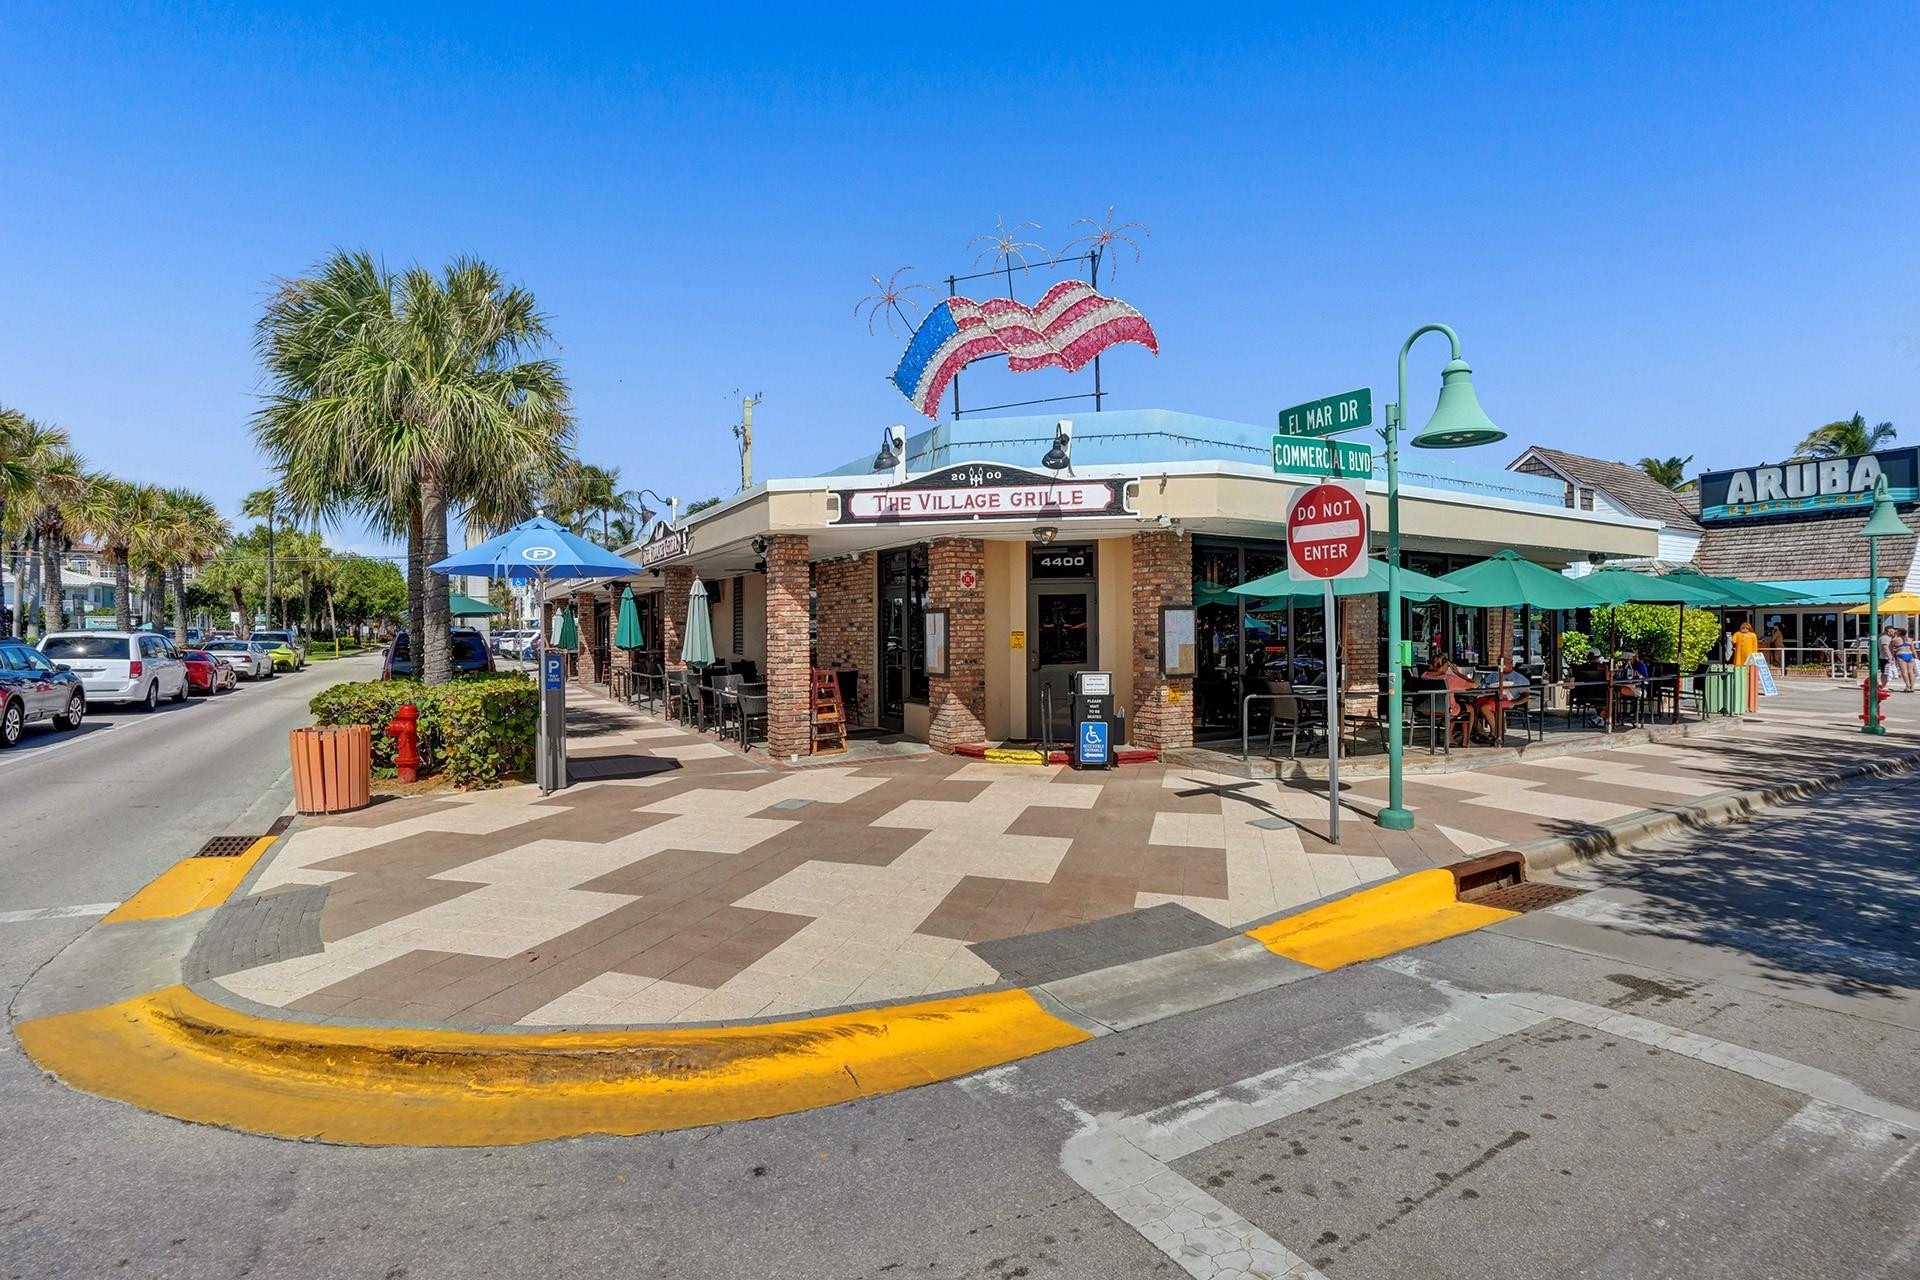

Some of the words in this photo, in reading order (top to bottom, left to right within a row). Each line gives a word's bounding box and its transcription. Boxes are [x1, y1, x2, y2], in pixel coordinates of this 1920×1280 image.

[1288, 414, 1302, 435] EL
[1306, 405, 1333, 430] MAR
[1339, 399, 1358, 423] DR
[1275, 444, 1346, 470] COMMERCIAL
[1348, 450, 1371, 472] BLVD
[951, 472, 966, 482] 20
[986, 471, 1002, 480] 00
[1727, 455, 1882, 504] ARUBA
[873, 494, 912, 512] THE
[918, 492, 1001, 510] VILLAGE
[1010, 489, 1083, 507] GRILLE
[1297, 505, 1316, 521] DO
[1323, 499, 1352, 518] NOT
[533, 550, 548, 559] P
[1041, 556, 1085, 567] 4400
[1304, 543, 1348, 561] ENTER
[548, 660, 560, 674] P
